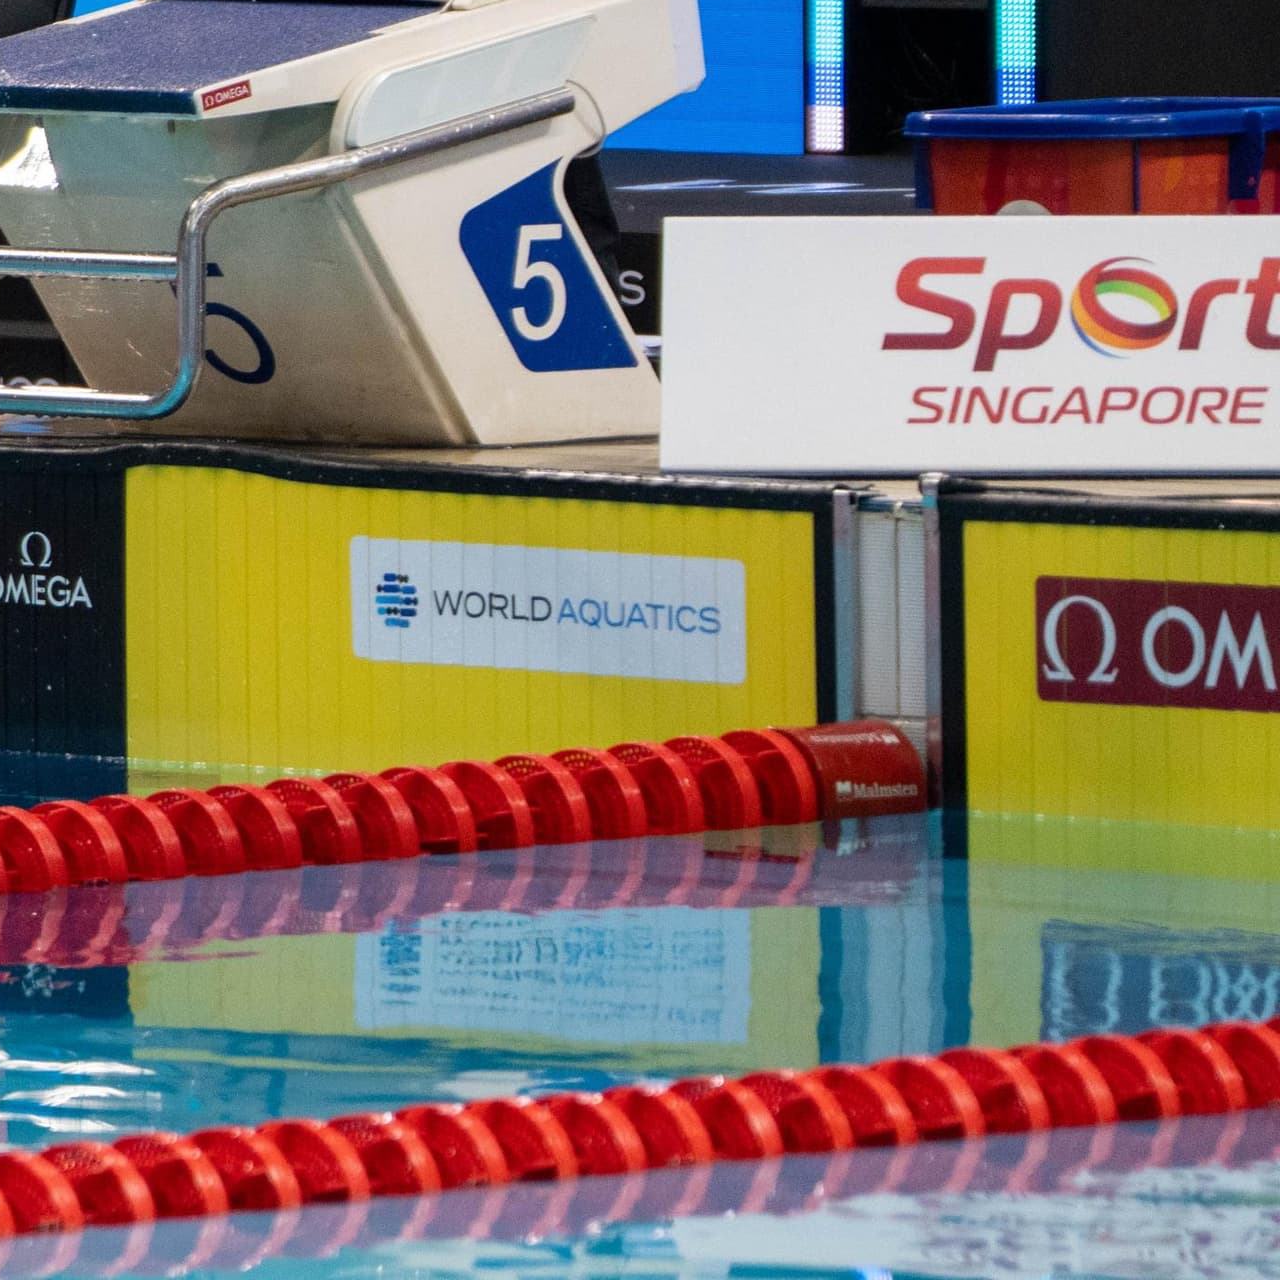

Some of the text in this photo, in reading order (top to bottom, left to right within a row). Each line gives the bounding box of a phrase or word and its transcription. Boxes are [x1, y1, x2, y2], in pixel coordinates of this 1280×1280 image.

[215, 85, 250, 103] OMEGA
[511, 223, 567, 341] 5
[906, 387, 1269, 424] SINGAPORE
[433, 588, 722, 636] WORLD AQUATICS
[1142, 605, 1278, 692] OM
